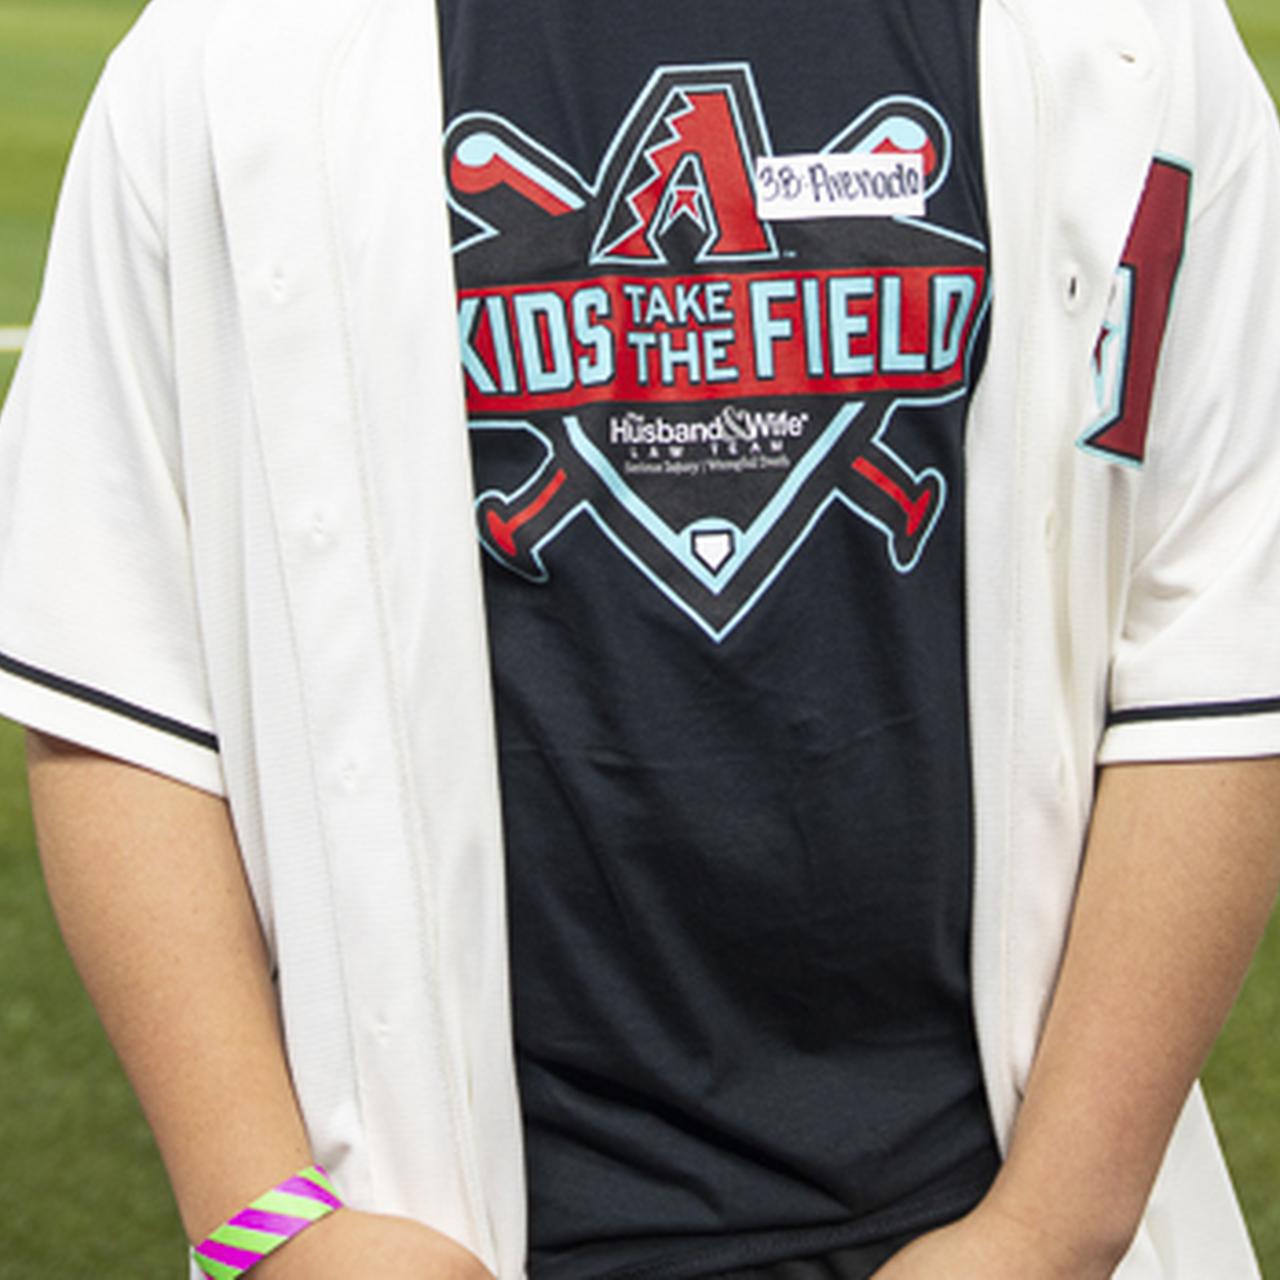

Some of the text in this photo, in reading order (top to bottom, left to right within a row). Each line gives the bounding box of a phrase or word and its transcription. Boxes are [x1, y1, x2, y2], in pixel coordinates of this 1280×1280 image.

[623, 281, 733, 324] TAKE
[750, 273, 977, 380] FIELD
[627, 328, 739, 387] THE
[630, 438, 784, 460] LAW TEAM
